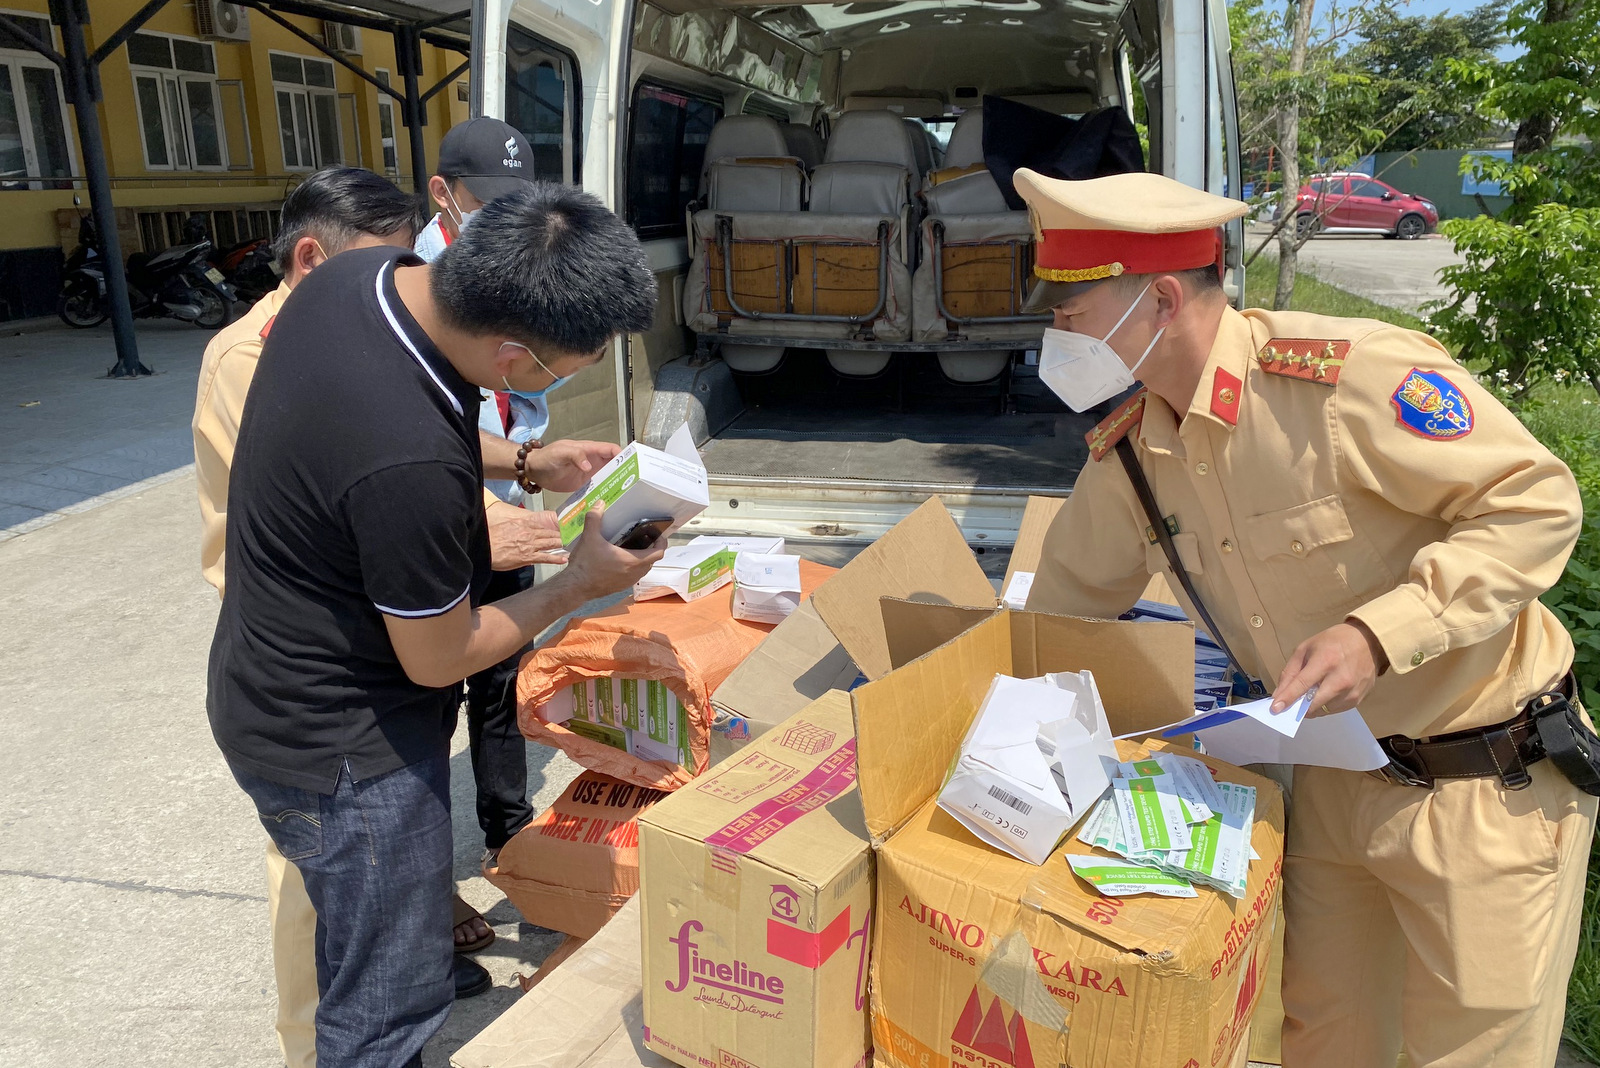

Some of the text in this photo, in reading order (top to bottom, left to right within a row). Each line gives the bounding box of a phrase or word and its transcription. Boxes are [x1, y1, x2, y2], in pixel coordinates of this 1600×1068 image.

[503, 158, 522, 168] egan
[1425, 390, 1458, 431] CSGT
[572, 779, 607, 805] USE
[604, 783, 634, 808] NO
[540, 812, 589, 842] MADE
[582, 818, 609, 845] IN
[775, 896, 794, 916] 4
[898, 894, 985, 949] AJINO
[665, 919, 785, 995] fineline
[693, 987, 783, 1020] Laundry Detergent
[652, 1034, 670, 1048] PRODUCT
[893, 1031, 917, 1057] 500
